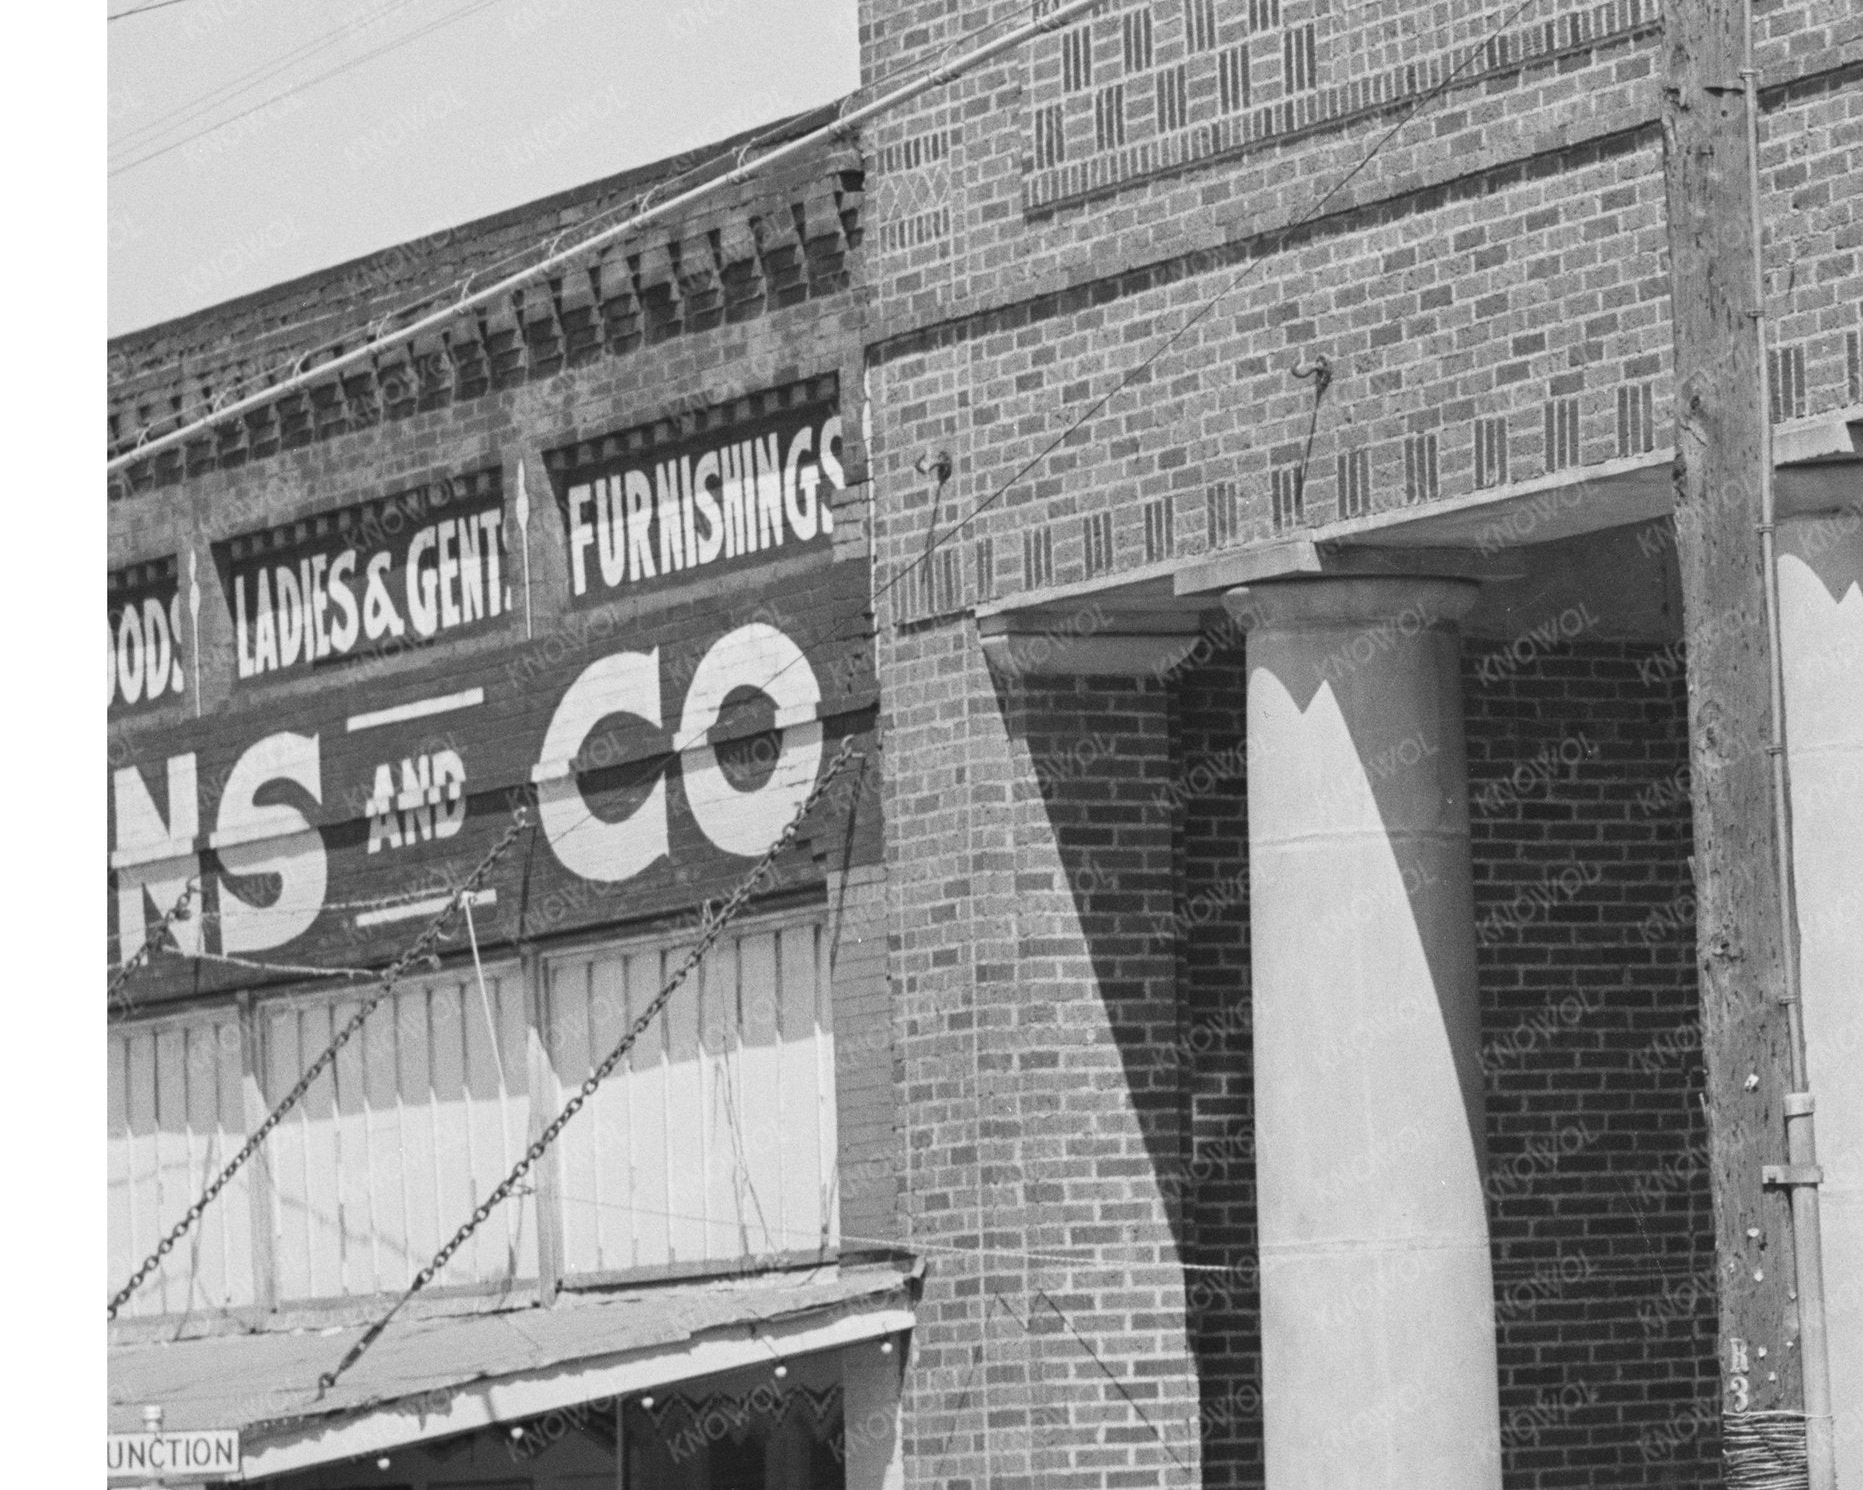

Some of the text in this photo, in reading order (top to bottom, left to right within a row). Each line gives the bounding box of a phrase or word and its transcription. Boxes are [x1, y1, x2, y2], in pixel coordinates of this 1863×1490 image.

[235, 549, 359, 679] LADIES
[406, 508, 512, 637] GENT
[568, 415, 846, 597] FURNISHINGS
[366, 749, 467, 855] AND
[530, 622, 824, 883] CO
[1730, 1376, 1749, 1412] 3
